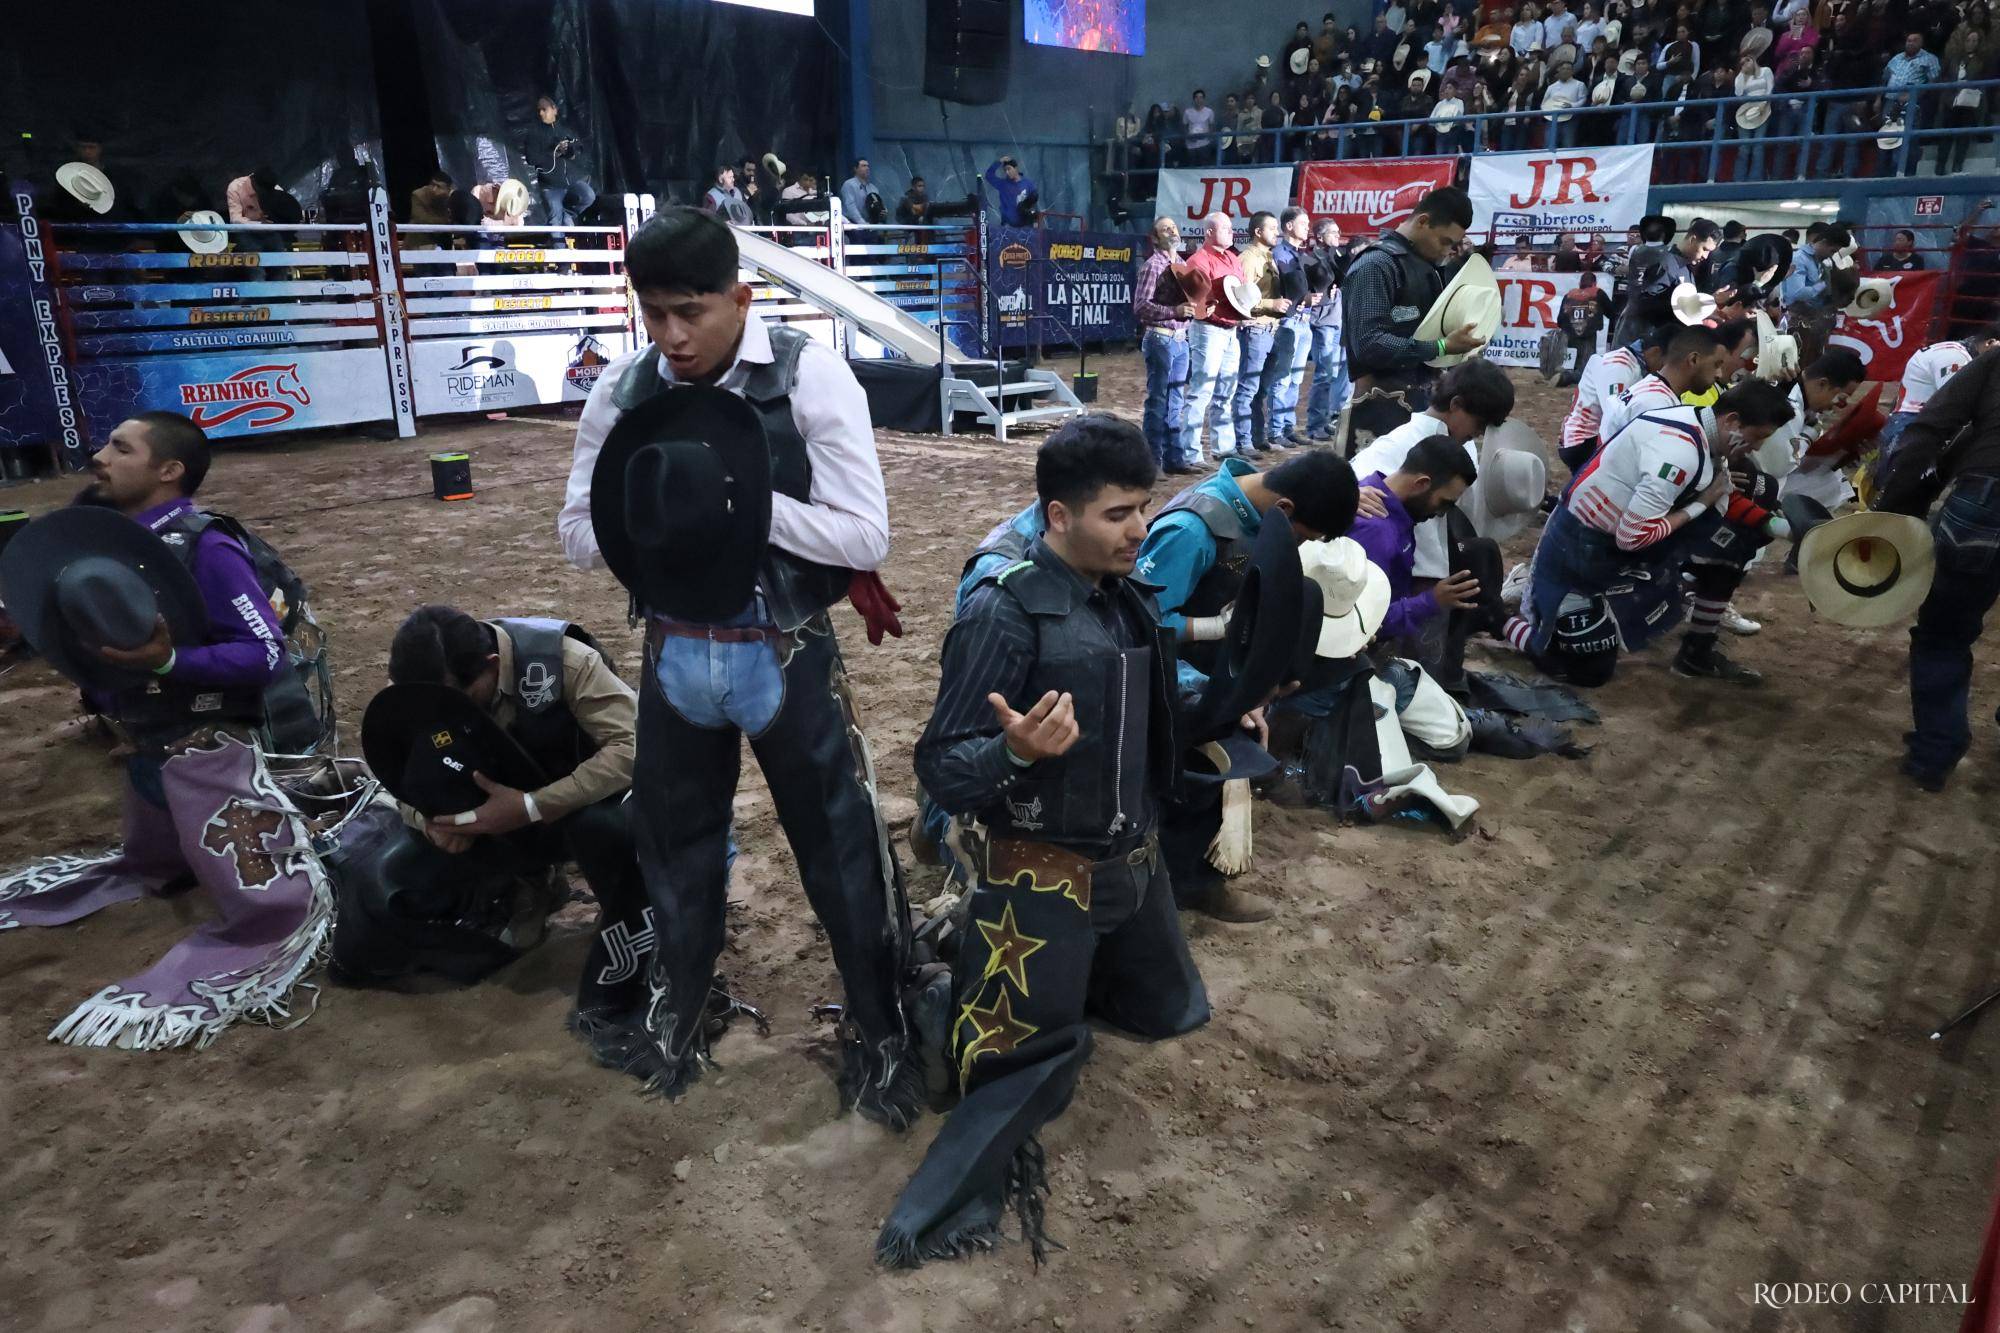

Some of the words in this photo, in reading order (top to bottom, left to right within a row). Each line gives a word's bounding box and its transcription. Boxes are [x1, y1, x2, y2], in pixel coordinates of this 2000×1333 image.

[1312, 189, 1396, 215] REINING
[494, 250, 545, 263] RODEO
[897, 244, 929, 254] RODEO
[1050, 243, 1083, 261] RODEO
[1083, 247, 1095, 259] DEL
[189, 253, 260, 268] RODEO
[1092, 273, 1108, 281] TOUR
[212, 287, 239, 298] DEL
[1048, 284, 1068, 305] LA
[1072, 283, 1132, 305] BATALLA
[375, 203, 390, 273] PONY
[387, 291, 409, 414] EXPRESS
[494, 296, 552, 309] DESIERTO
[17, 194, 44, 283] PONY
[36, 300, 79, 449] EXPRESS
[190, 307, 270, 323] DESIERTO
[1071, 304, 1111, 326] FINAL
[1573, 309, 1584, 319] 01
[173, 335, 233, 347] SALTILLO,
[237, 332, 296, 344] COAHUILA
[180, 380, 269, 405] REINING
[447, 373, 515, 396] RIDEMAN
